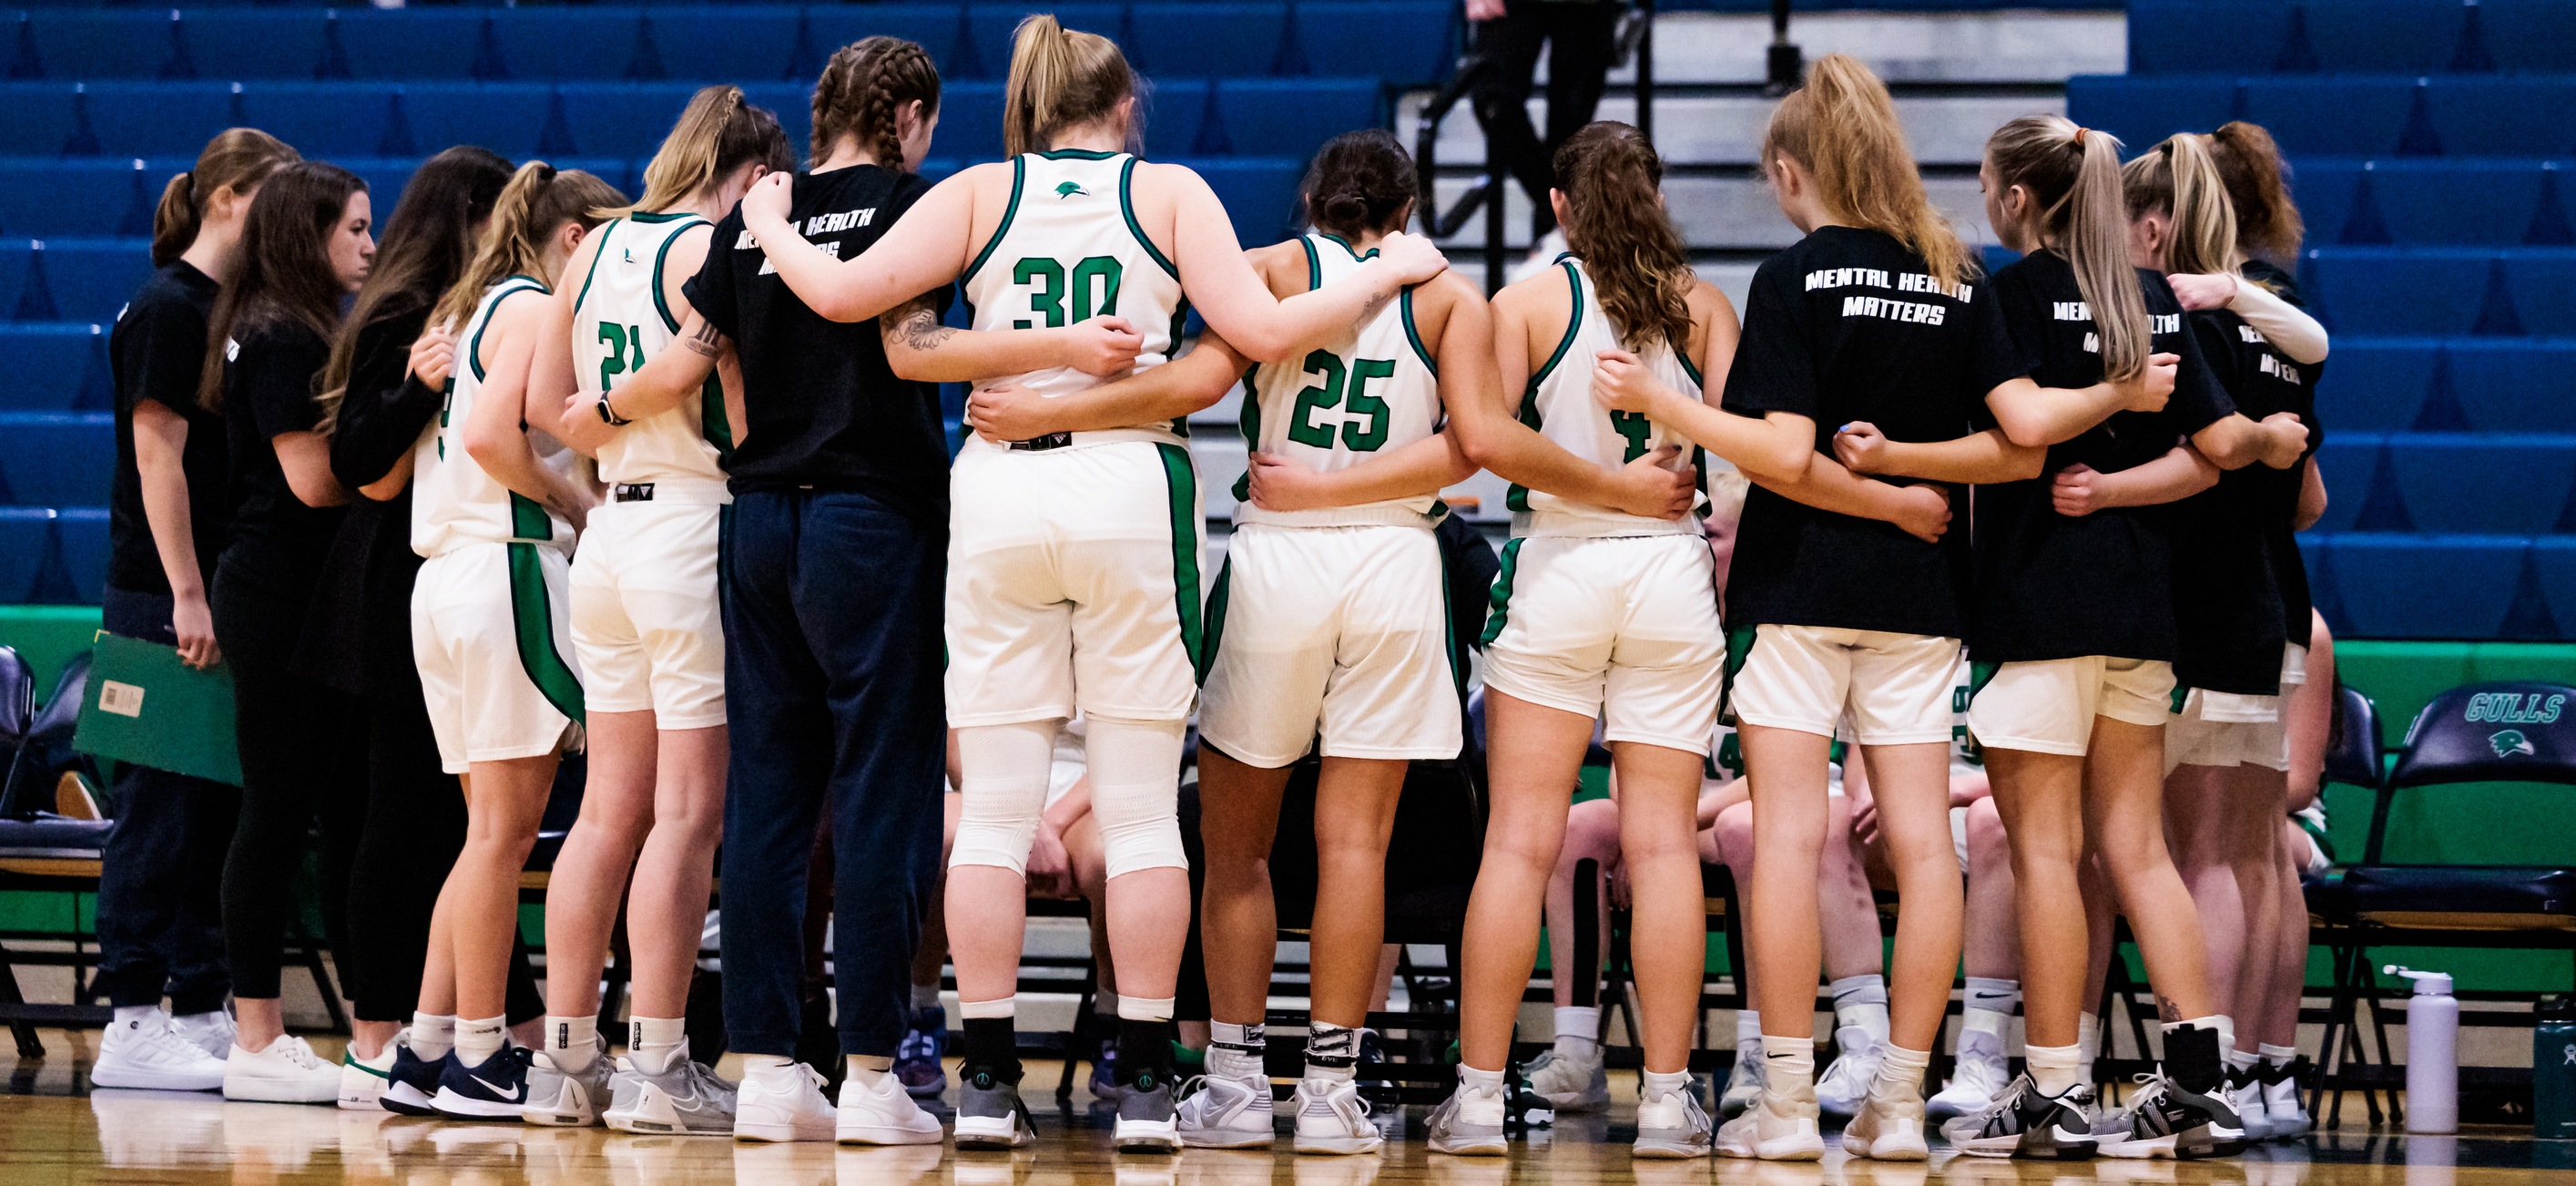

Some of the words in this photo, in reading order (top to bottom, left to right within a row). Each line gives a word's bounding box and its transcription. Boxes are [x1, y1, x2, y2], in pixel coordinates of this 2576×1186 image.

[805, 208, 876, 236] HEALTH
[1013, 255, 1124, 330] 30
[1806, 268, 1891, 291] MENTAL
[1842, 296, 1946, 326] MATTERS
[2053, 302, 2092, 321] MEN
[598, 321, 646, 392] 21
[1288, 348, 1397, 452] 25
[2464, 692, 2566, 723] GULLS
